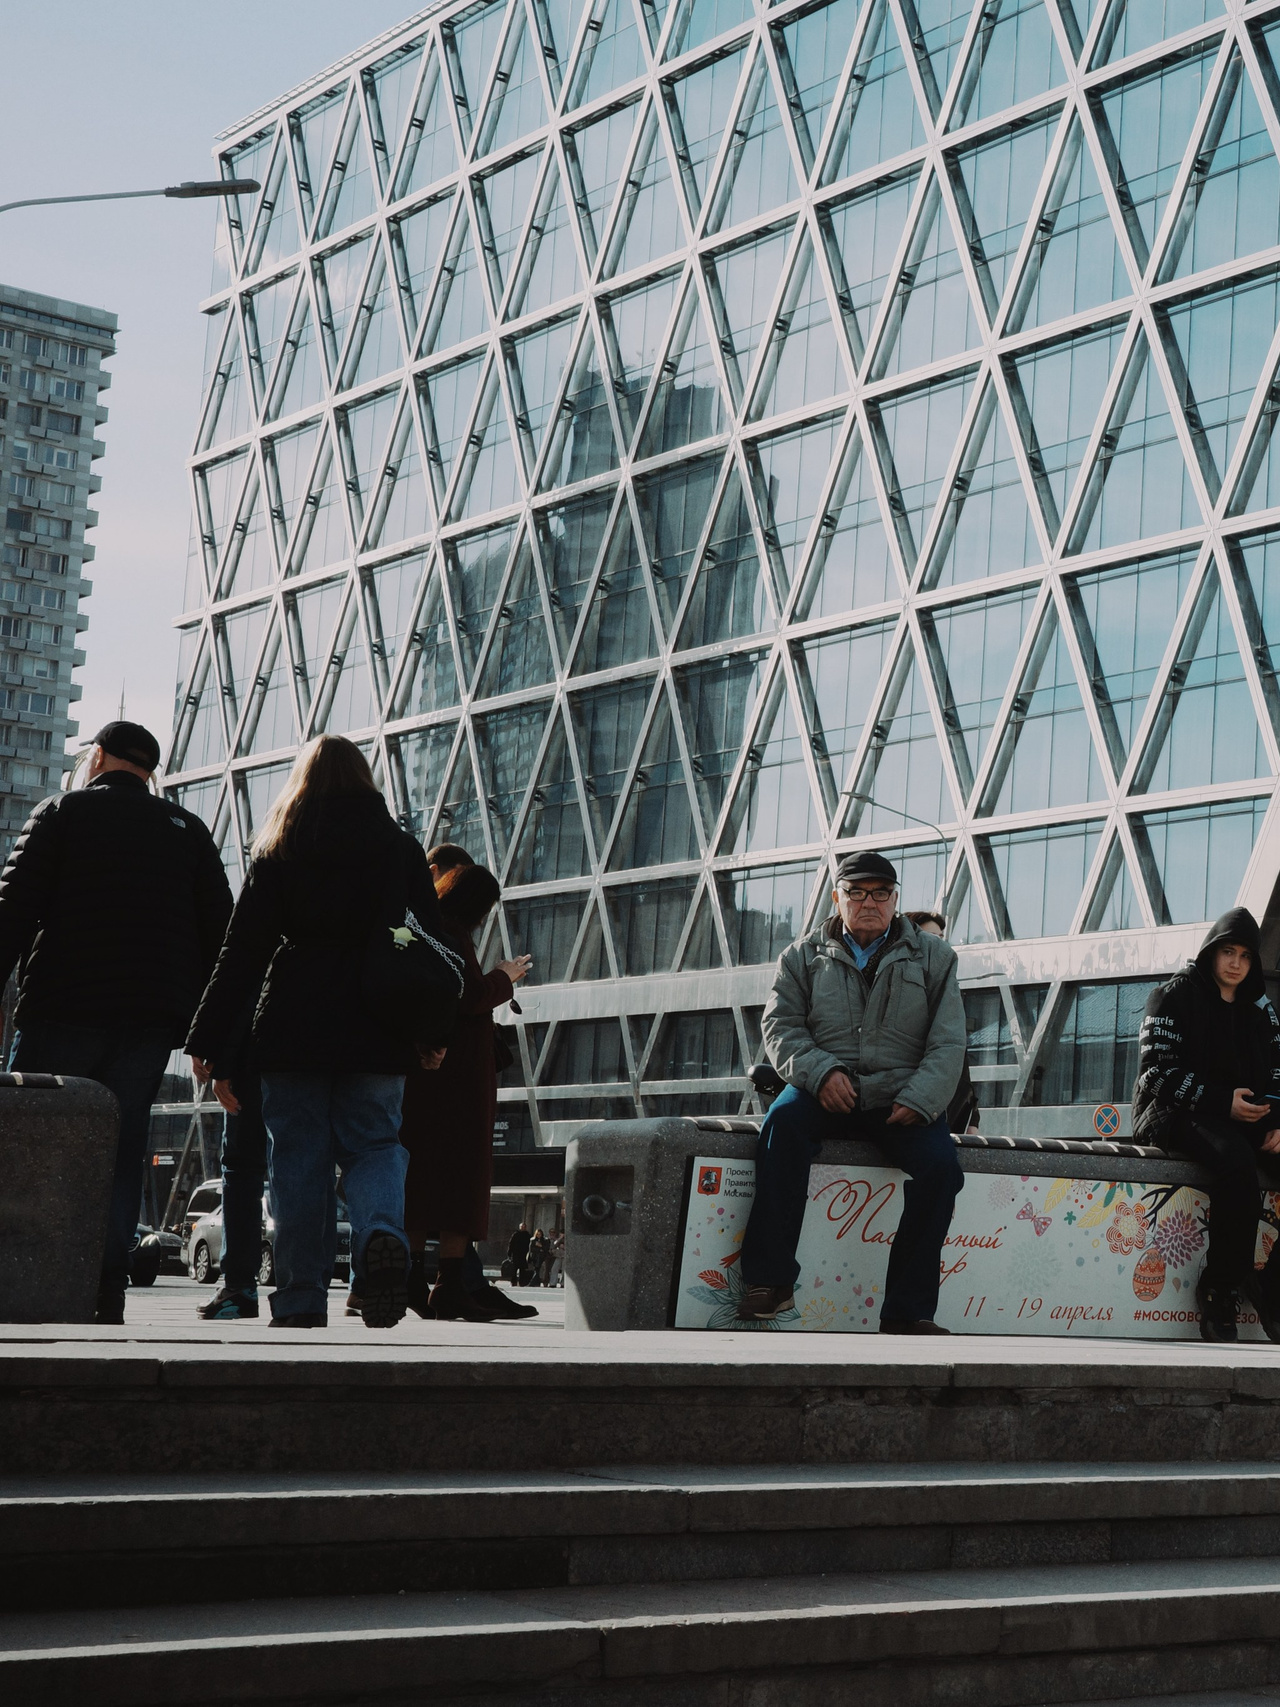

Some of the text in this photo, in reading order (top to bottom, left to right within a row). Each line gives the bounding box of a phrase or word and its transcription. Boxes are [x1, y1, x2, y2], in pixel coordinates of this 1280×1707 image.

[726, 1168, 753, 1176] Проект
[724, 1189, 753, 1198] Москвы
[964, 1296, 987, 1317] 11
[1016, 1297, 1043, 1319] 19
[1050, 1304, 1114, 1330] апреля
